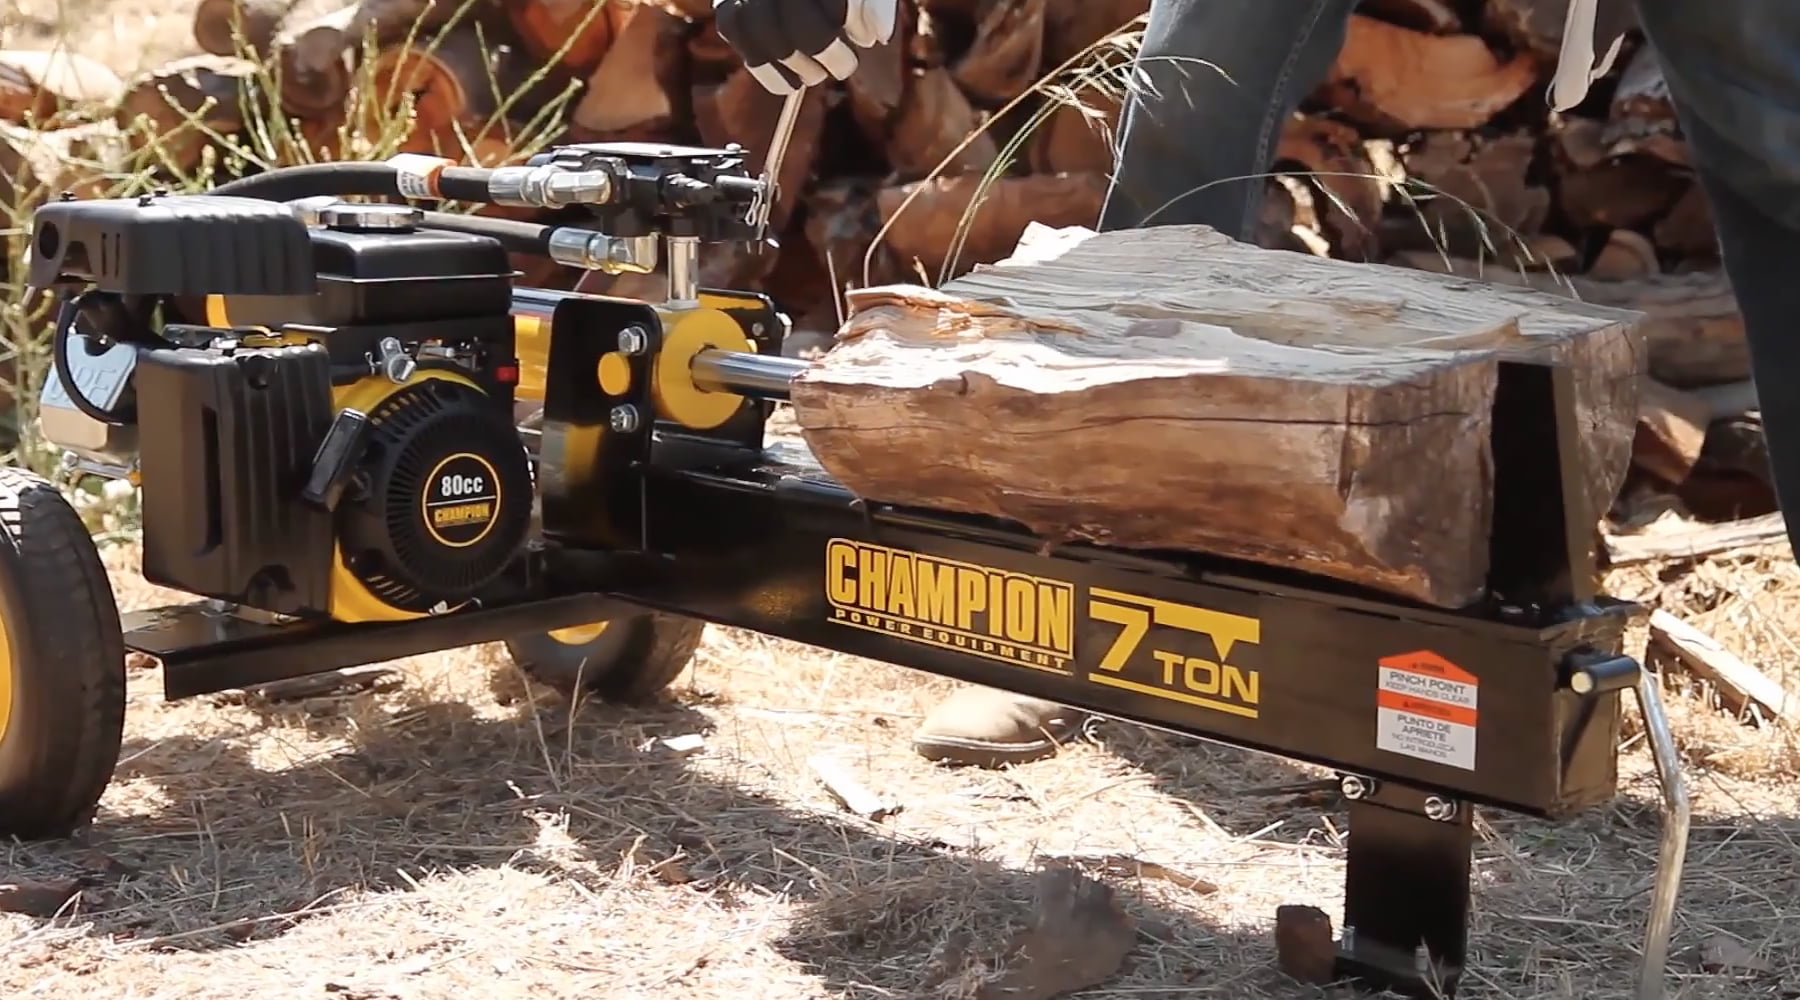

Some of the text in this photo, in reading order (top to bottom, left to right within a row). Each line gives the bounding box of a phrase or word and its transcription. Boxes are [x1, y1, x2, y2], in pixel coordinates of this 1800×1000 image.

[441, 474, 483, 497] 80cc
[829, 541, 1071, 655] CHAMPION
[835, 608, 1066, 669] POWER EQUIPMENT
[1089, 600, 1258, 704] 7 TON
[1390, 671, 1466, 695] PINCH POINT
[1397, 714, 1451, 734] PUNTO DE
[1402, 725, 1447, 742] APRIETE
